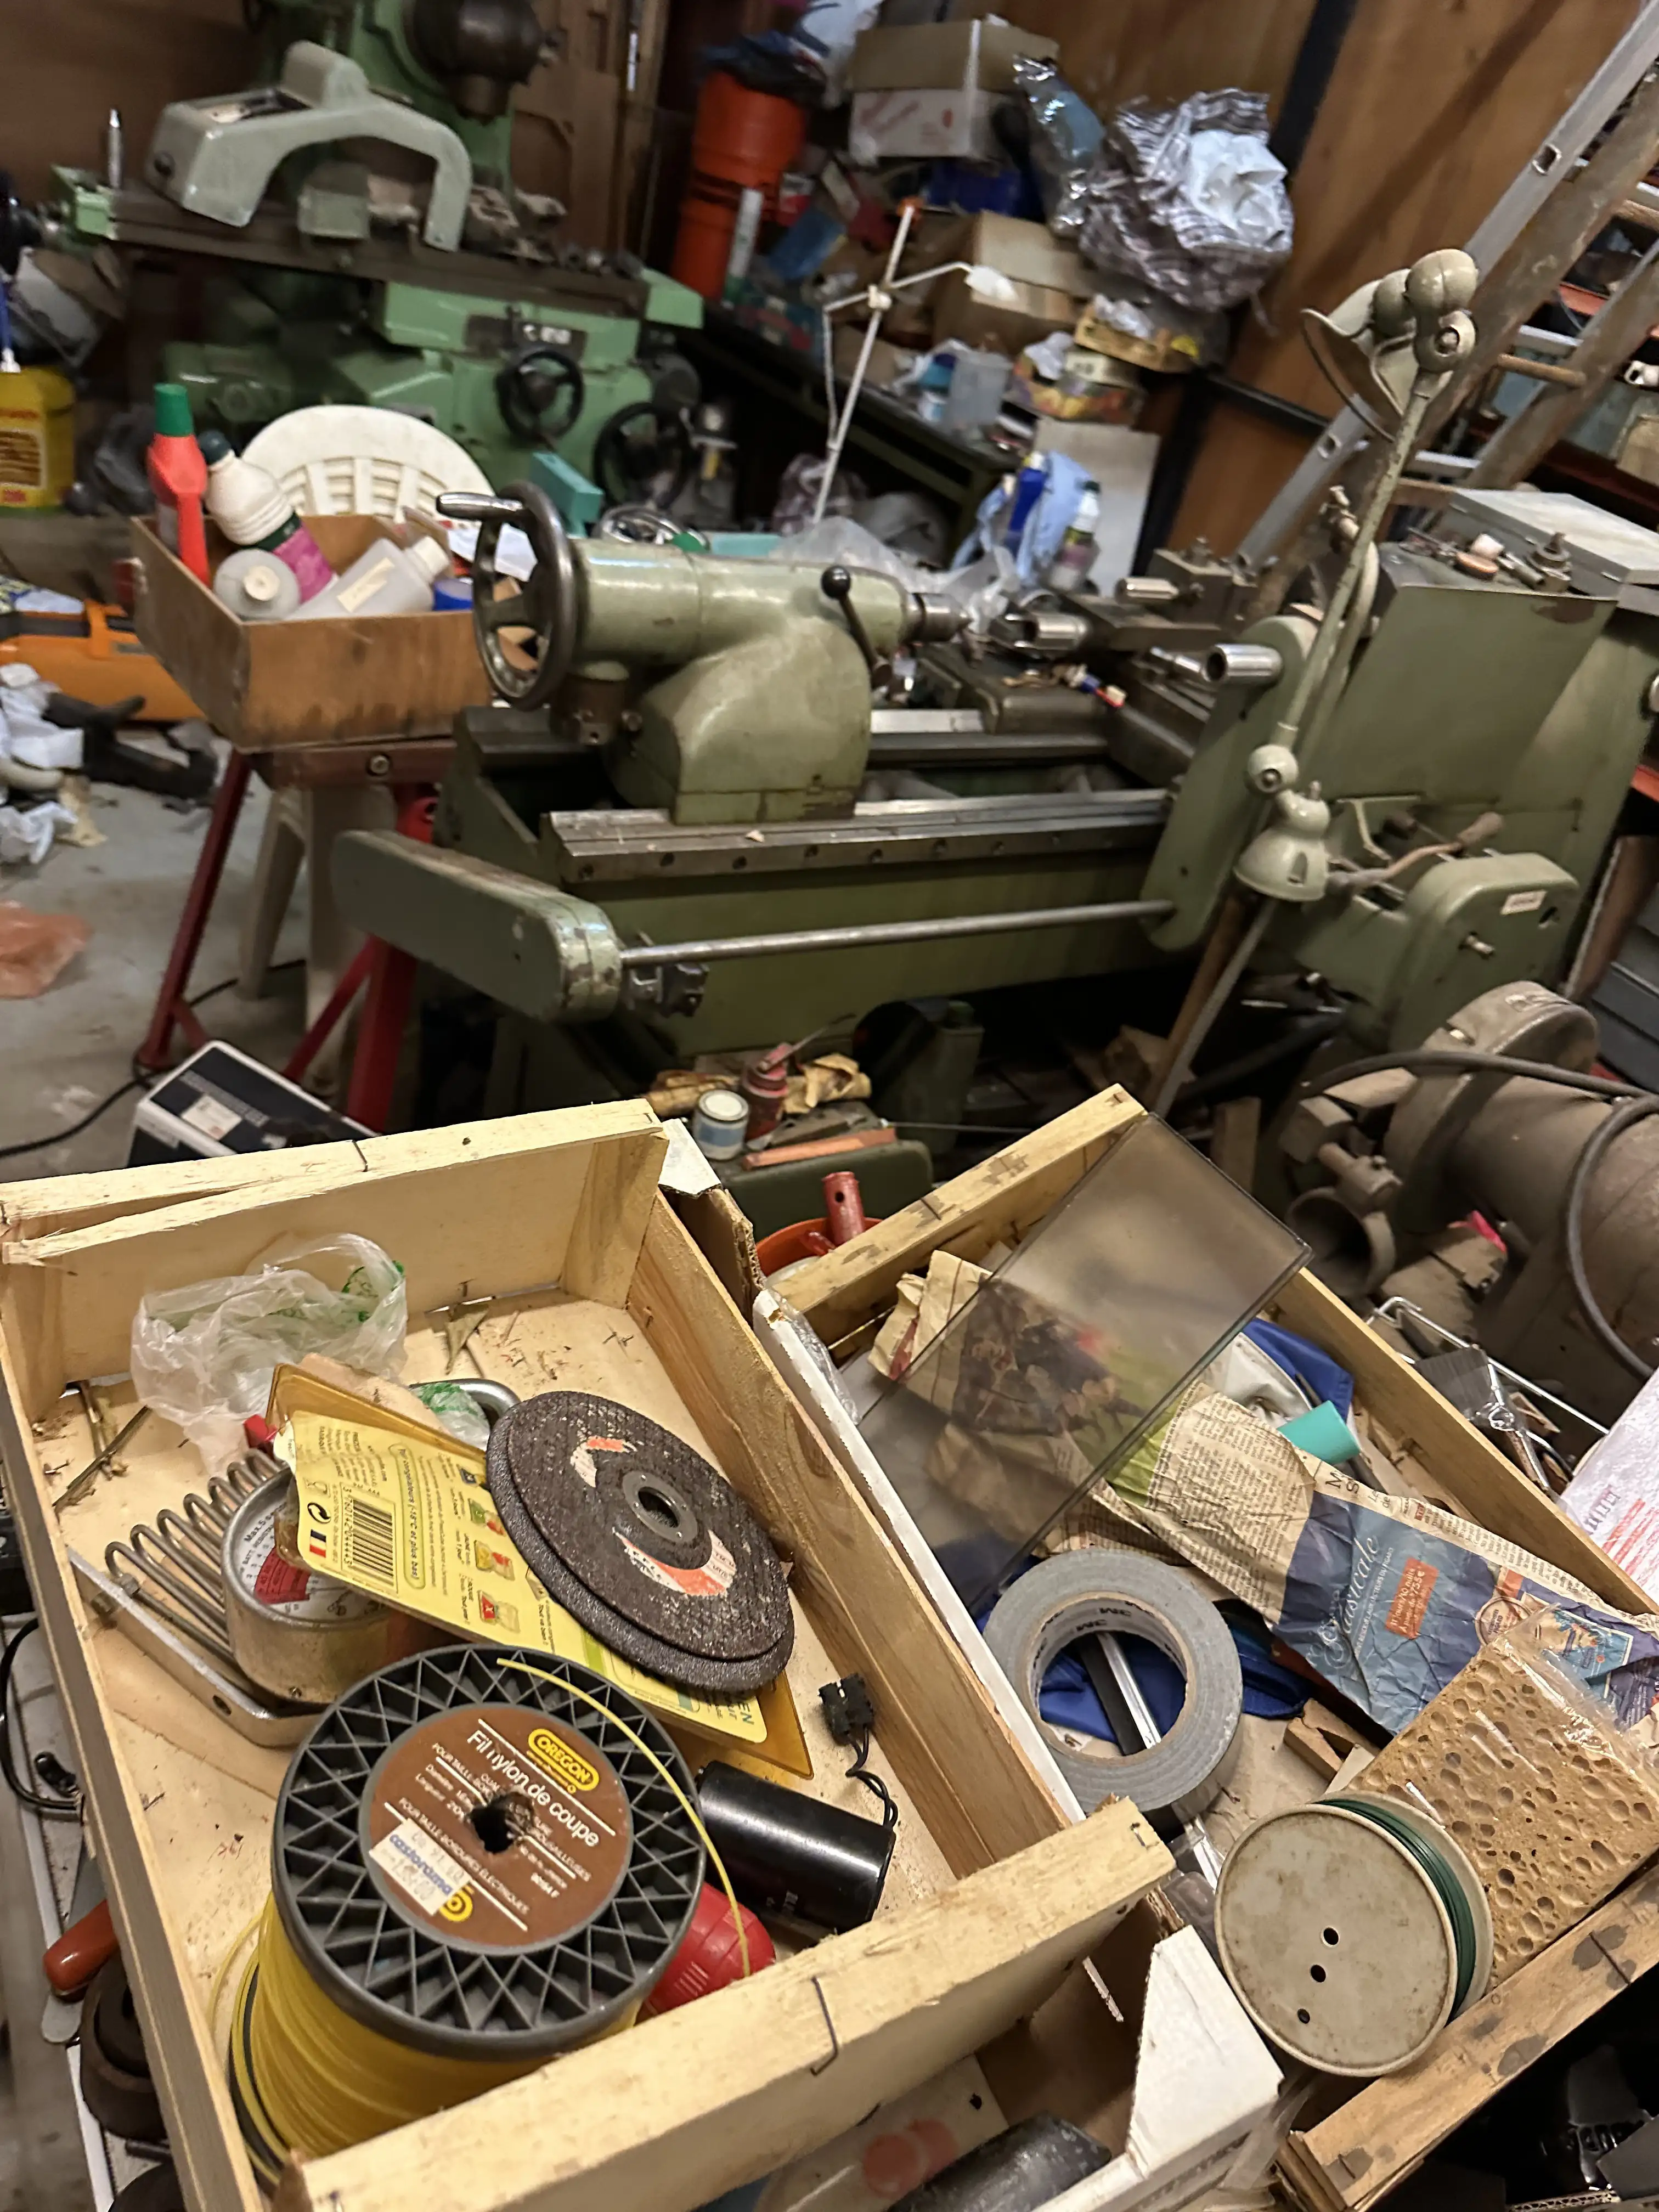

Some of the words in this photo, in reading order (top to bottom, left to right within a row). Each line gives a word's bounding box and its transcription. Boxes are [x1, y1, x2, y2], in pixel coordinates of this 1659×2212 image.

[410, 1530, 417, 1539] et
[409, 1539, 419, 1559] plus
[1383, 1546, 1394, 1567] FIGARO
[1099, 1606, 1131, 1618] 3M
[1076, 1618, 1107, 1631] 3M
[537, 1737, 591, 1782] OREGON
[467, 1730, 492, 1753] Fil
[487, 1749, 531, 1790] nylon
[529, 1781, 551, 1805] de
[549, 1802, 599, 1847] coupe
[399, 1798, 420, 1818] POUR
[389, 1834, 454, 1895] castorama
